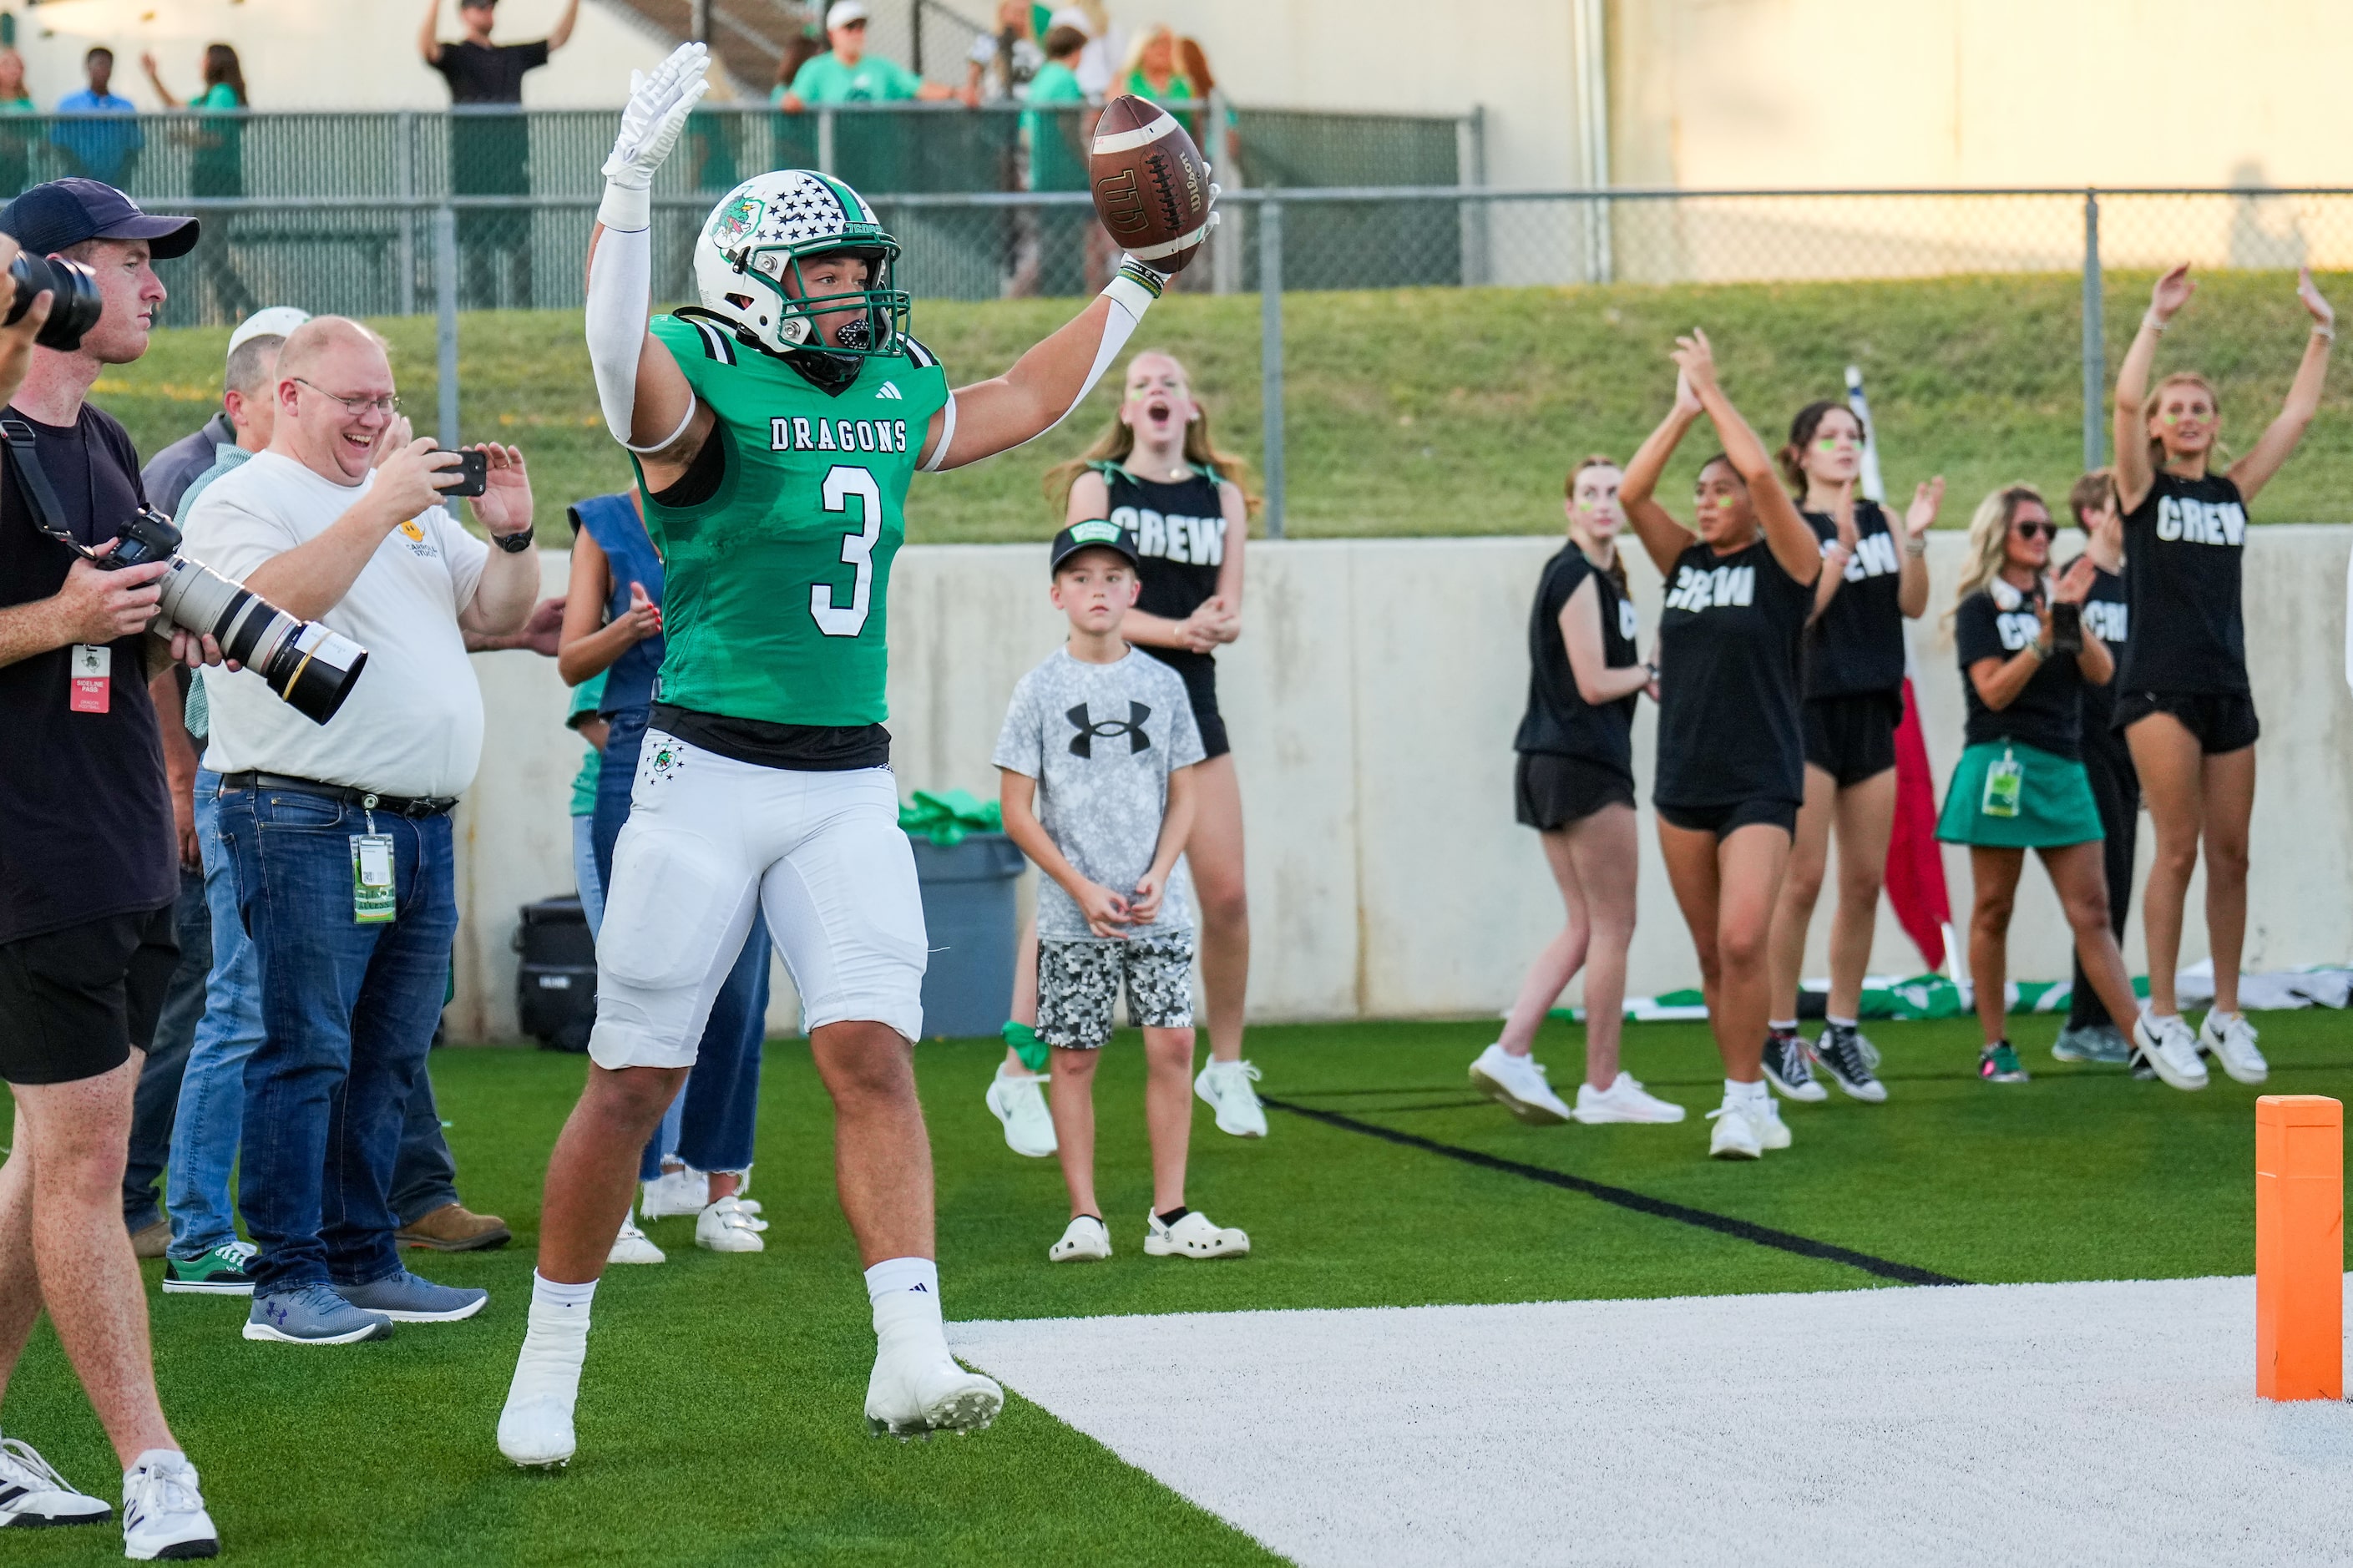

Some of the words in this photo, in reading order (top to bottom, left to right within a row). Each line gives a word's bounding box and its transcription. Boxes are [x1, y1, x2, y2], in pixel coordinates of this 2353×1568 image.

[1178, 150, 1201, 215] Wilson
[770, 417, 907, 453] DRAGONS
[809, 464, 883, 638] 3
[1110, 506, 1227, 566] CREW
[77, 680, 104, 688] SIDELINE
[358, 901, 390, 910] ACCESS
